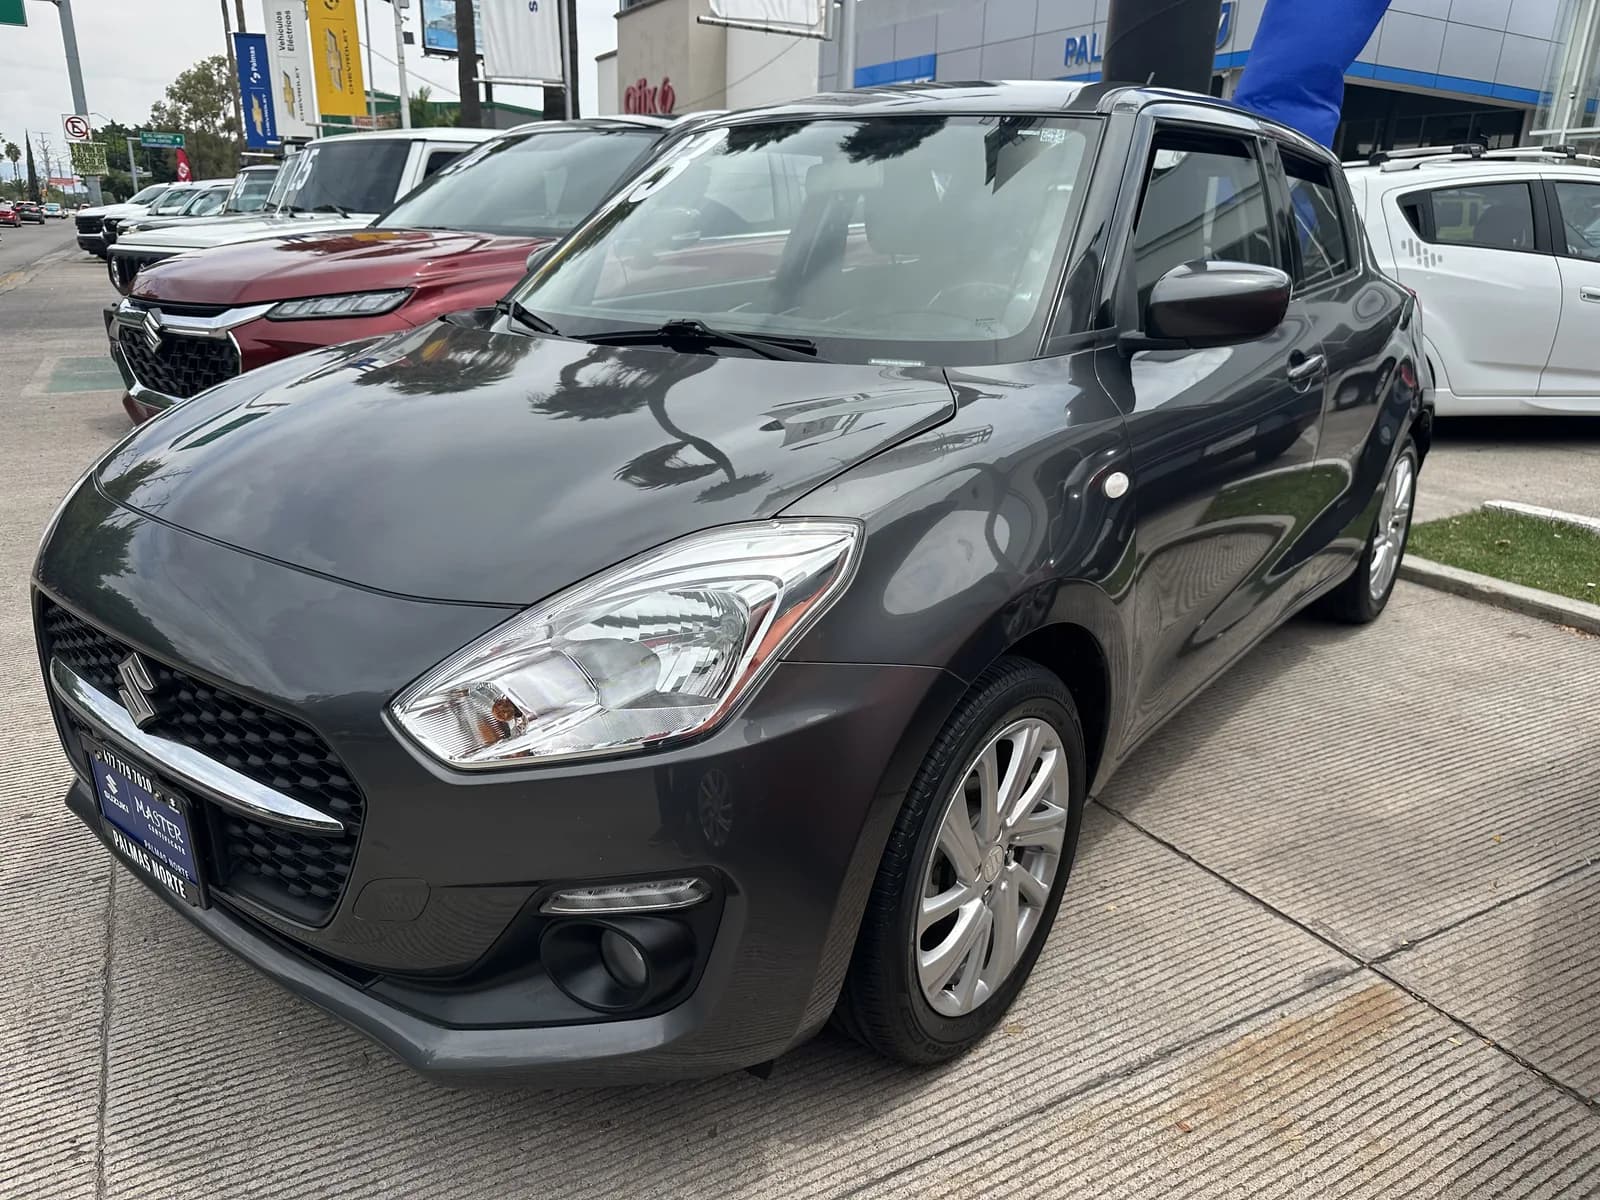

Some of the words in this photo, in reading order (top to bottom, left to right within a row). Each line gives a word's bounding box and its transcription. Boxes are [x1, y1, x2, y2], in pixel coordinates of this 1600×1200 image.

[249, 46, 258, 72] Palmas
[342, 29, 354, 95] CHEVROLET
[295, 67, 304, 121] CHEVROLET
[117, 760, 132, 780] 779
[132, 769, 153, 794] 7010
[104, 790, 129, 813] SUZUKI
[134, 795, 184, 844] MASTER
[112, 829, 151, 873] PALMAS
[151, 859, 187, 899] NORTE
[144, 839, 168, 864] PALMAS
[168, 858, 190, 880] NORTE
